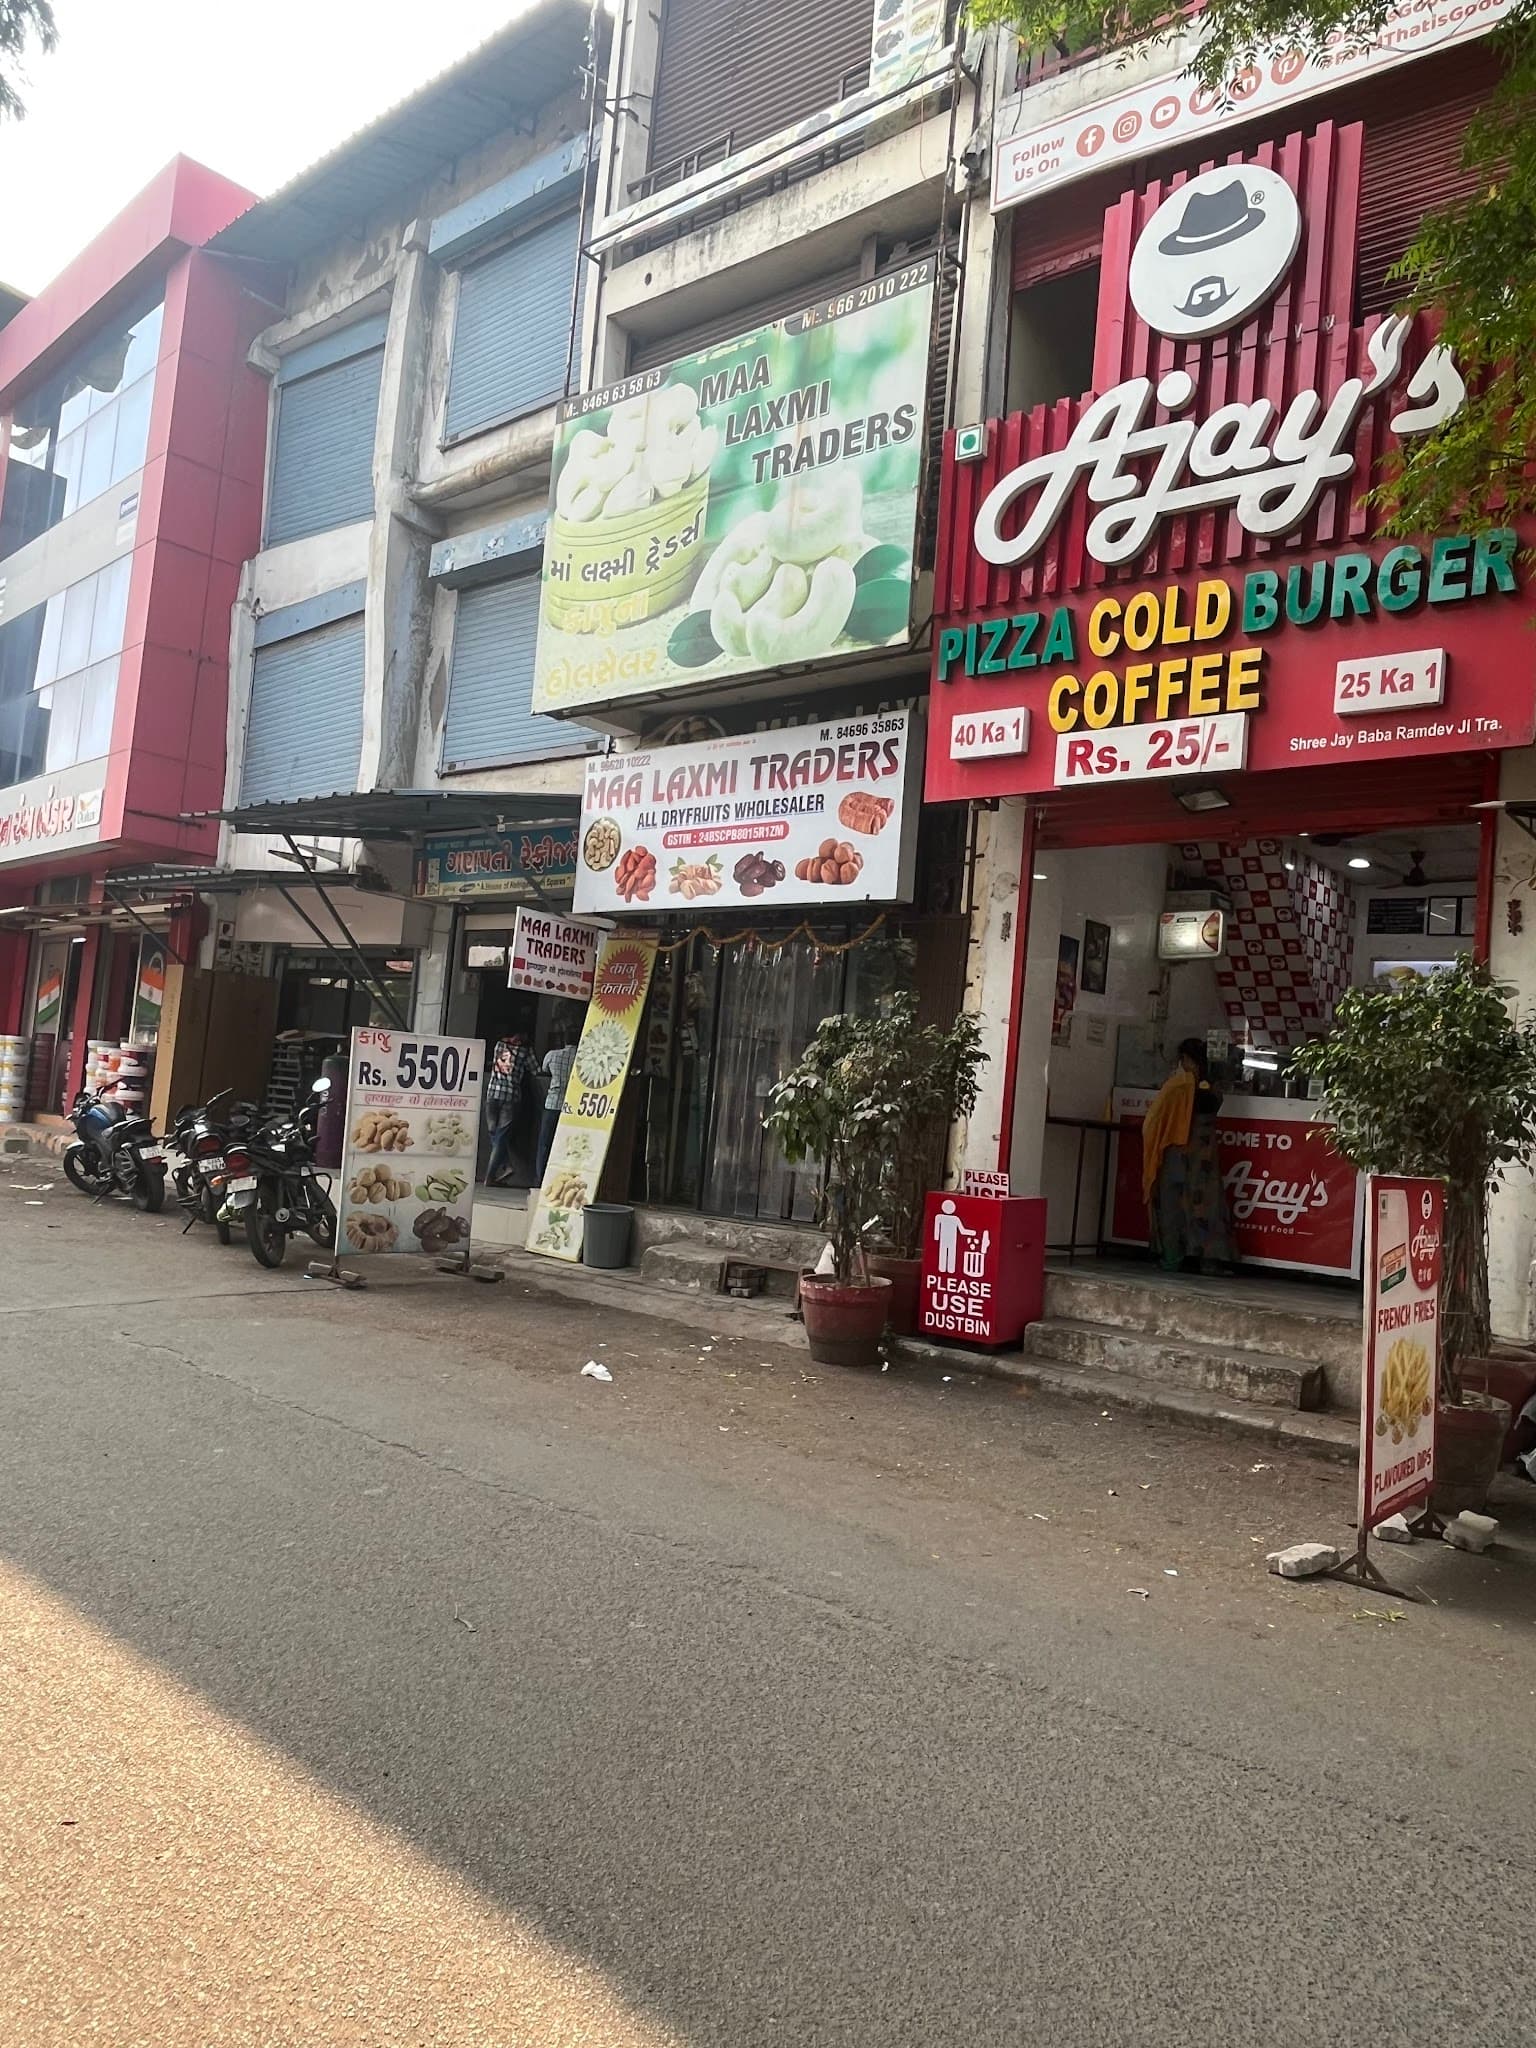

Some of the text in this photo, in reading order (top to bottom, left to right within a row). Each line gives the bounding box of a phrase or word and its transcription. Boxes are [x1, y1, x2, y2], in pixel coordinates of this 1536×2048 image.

[1012, 134, 1065, 166] Follow
[1014, 155, 1060, 183] Us On
[827, 294, 855, 319] 966
[857, 278, 895, 307] 2010
[899, 264, 929, 291] 222
[582, 391, 609, 413] 8469
[612, 383, 626, 401] 63
[629, 377, 643, 395] 58
[699, 355, 772, 410] MAA
[724, 379, 832, 446] LAXMI
[752, 402, 917, 484] TRADERS
[974, 313, 1467, 565] Ajay's
[581, 546, 636, 583] લક્ષ્મી
[645, 506, 705, 575] ટ્રેડર્સ
[938, 527, 1519, 682] PIZZA COLD BURGER
[1048, 647, 1263, 733] COFFEE
[1341, 662, 1438, 700] 25 Ka 1
[821, 717, 905, 741] M. 84696 35863
[954, 710, 1022, 746] 40 Ka 1
[1290, 736, 1328, 751] Shree
[1330, 733, 1354, 749] Jay
[1358, 728, 1393, 745] Baba
[1396, 722, 1454, 740] Ramdev
[1475, 716, 1503, 732] Tra.
[1066, 723, 1230, 778] Rs. 25/-
[586, 738, 900, 812] MAA LAXMI TRADERS
[637, 794, 825, 829] ALL DRYFRUITS WHOLESALER
[667, 833, 692, 847] GSTIN
[521, 915, 595, 948] MAA LAXMI
[527, 937, 586, 966] TRADERS
[358, 1043, 478, 1092] Rs. 550/-
[577, 1092, 615, 1119] 550/-
[1265, 1134, 1292, 1150] TO
[965, 1171, 1008, 1187] PLEASE
[1223, 1161, 1329, 1225] Ajay's
[926, 1275, 992, 1299] PLEASE
[932, 1292, 985, 1318] USE
[925, 1312, 990, 1337] DUSTBIN
[1378, 1298, 1436, 1334] FRENCH FRIES
